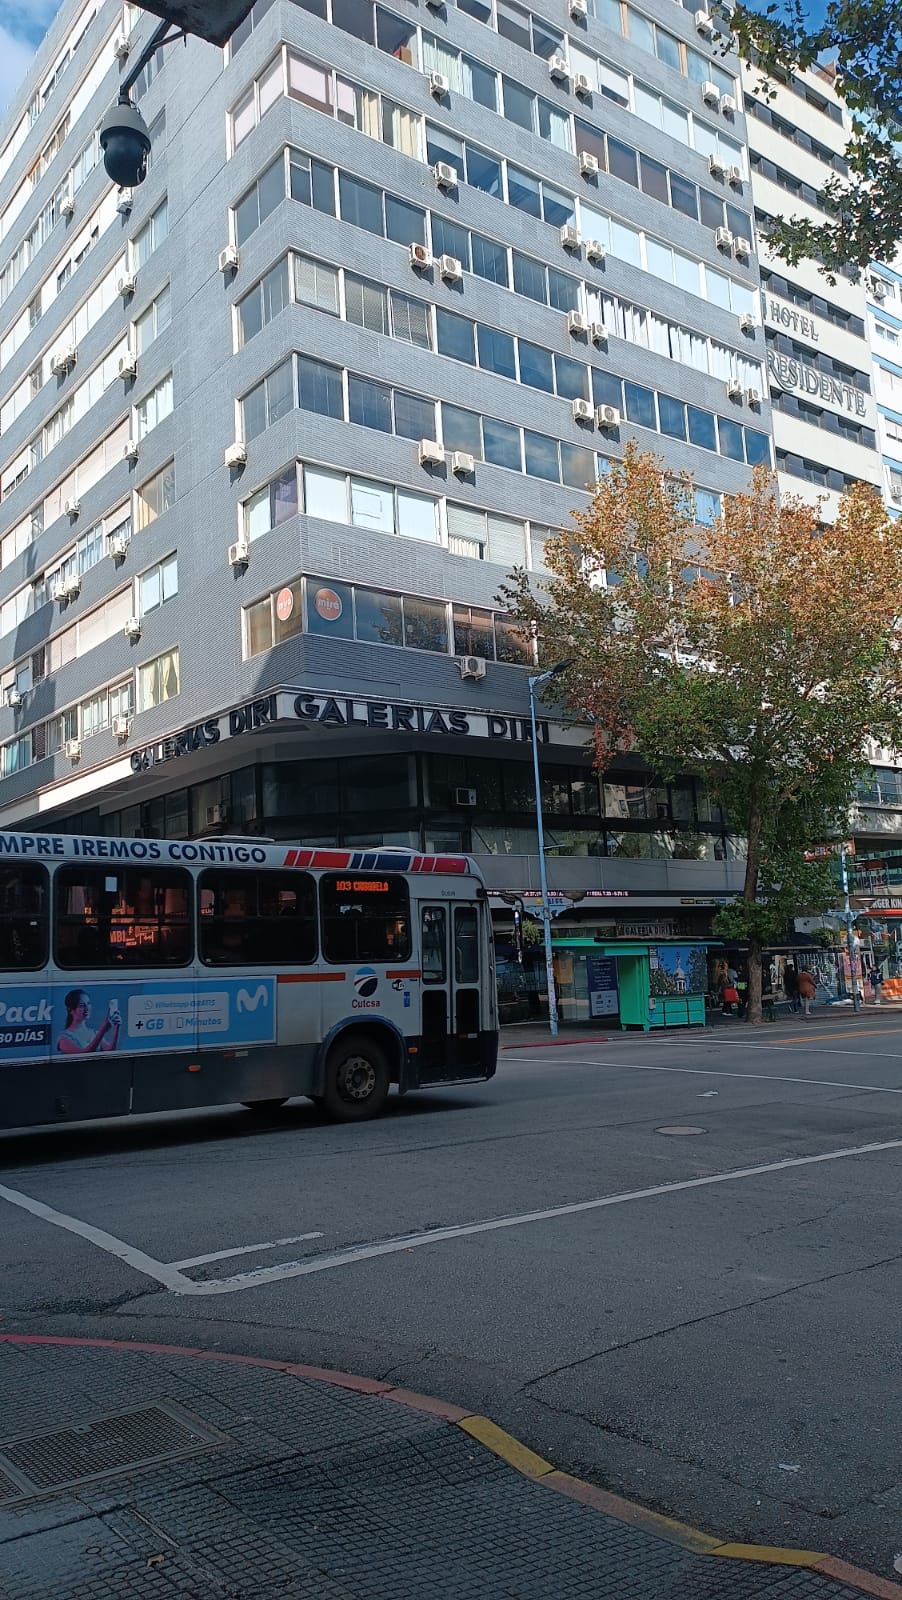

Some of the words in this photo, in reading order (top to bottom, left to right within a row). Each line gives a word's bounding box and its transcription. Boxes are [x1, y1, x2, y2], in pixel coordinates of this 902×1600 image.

[770, 300, 819, 342] HOTEL
[767, 350, 867, 417] RESIDENTE
[131, 719, 220, 772] GALERIAS
[229, 694, 278, 736] DIRI
[294, 694, 470, 735] GALERIAS
[487, 715, 549, 743] DIRI
[0, 836, 64, 855] MPRE
[73, 839, 161, 860] IREMOS
[168, 843, 266, 863] CONTIGO
[352, 999, 381, 1009] Cutcsa
[15, 1029, 45, 1043] DÍAS
[185, 1017, 222, 1027] Minutos
